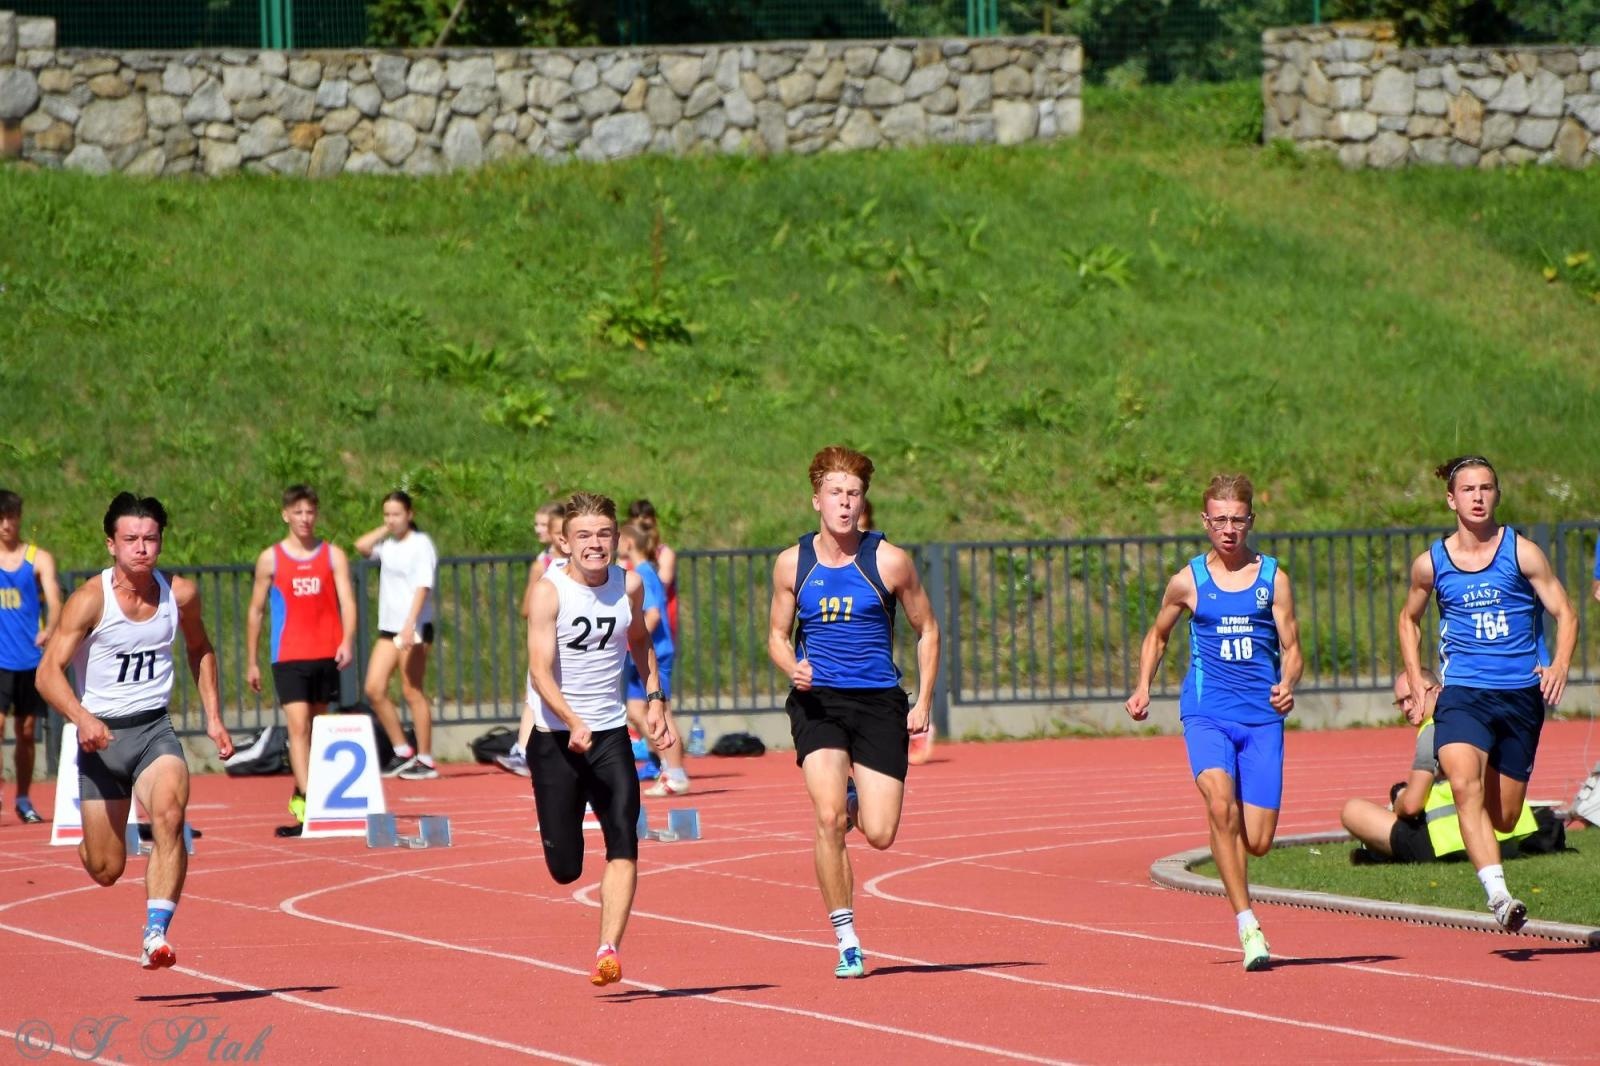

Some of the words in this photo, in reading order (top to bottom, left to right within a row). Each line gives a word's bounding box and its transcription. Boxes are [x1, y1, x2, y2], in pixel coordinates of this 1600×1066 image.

[292, 577, 321, 596] 550
[1462, 588, 1501, 603] PIAST
[819, 596, 853, 623] 127
[566, 616, 617, 652] 27
[1471, 610, 1509, 640] 764
[1220, 637, 1253, 661] 418
[116, 650, 156, 682] 777
[322, 739, 368, 810] 2
